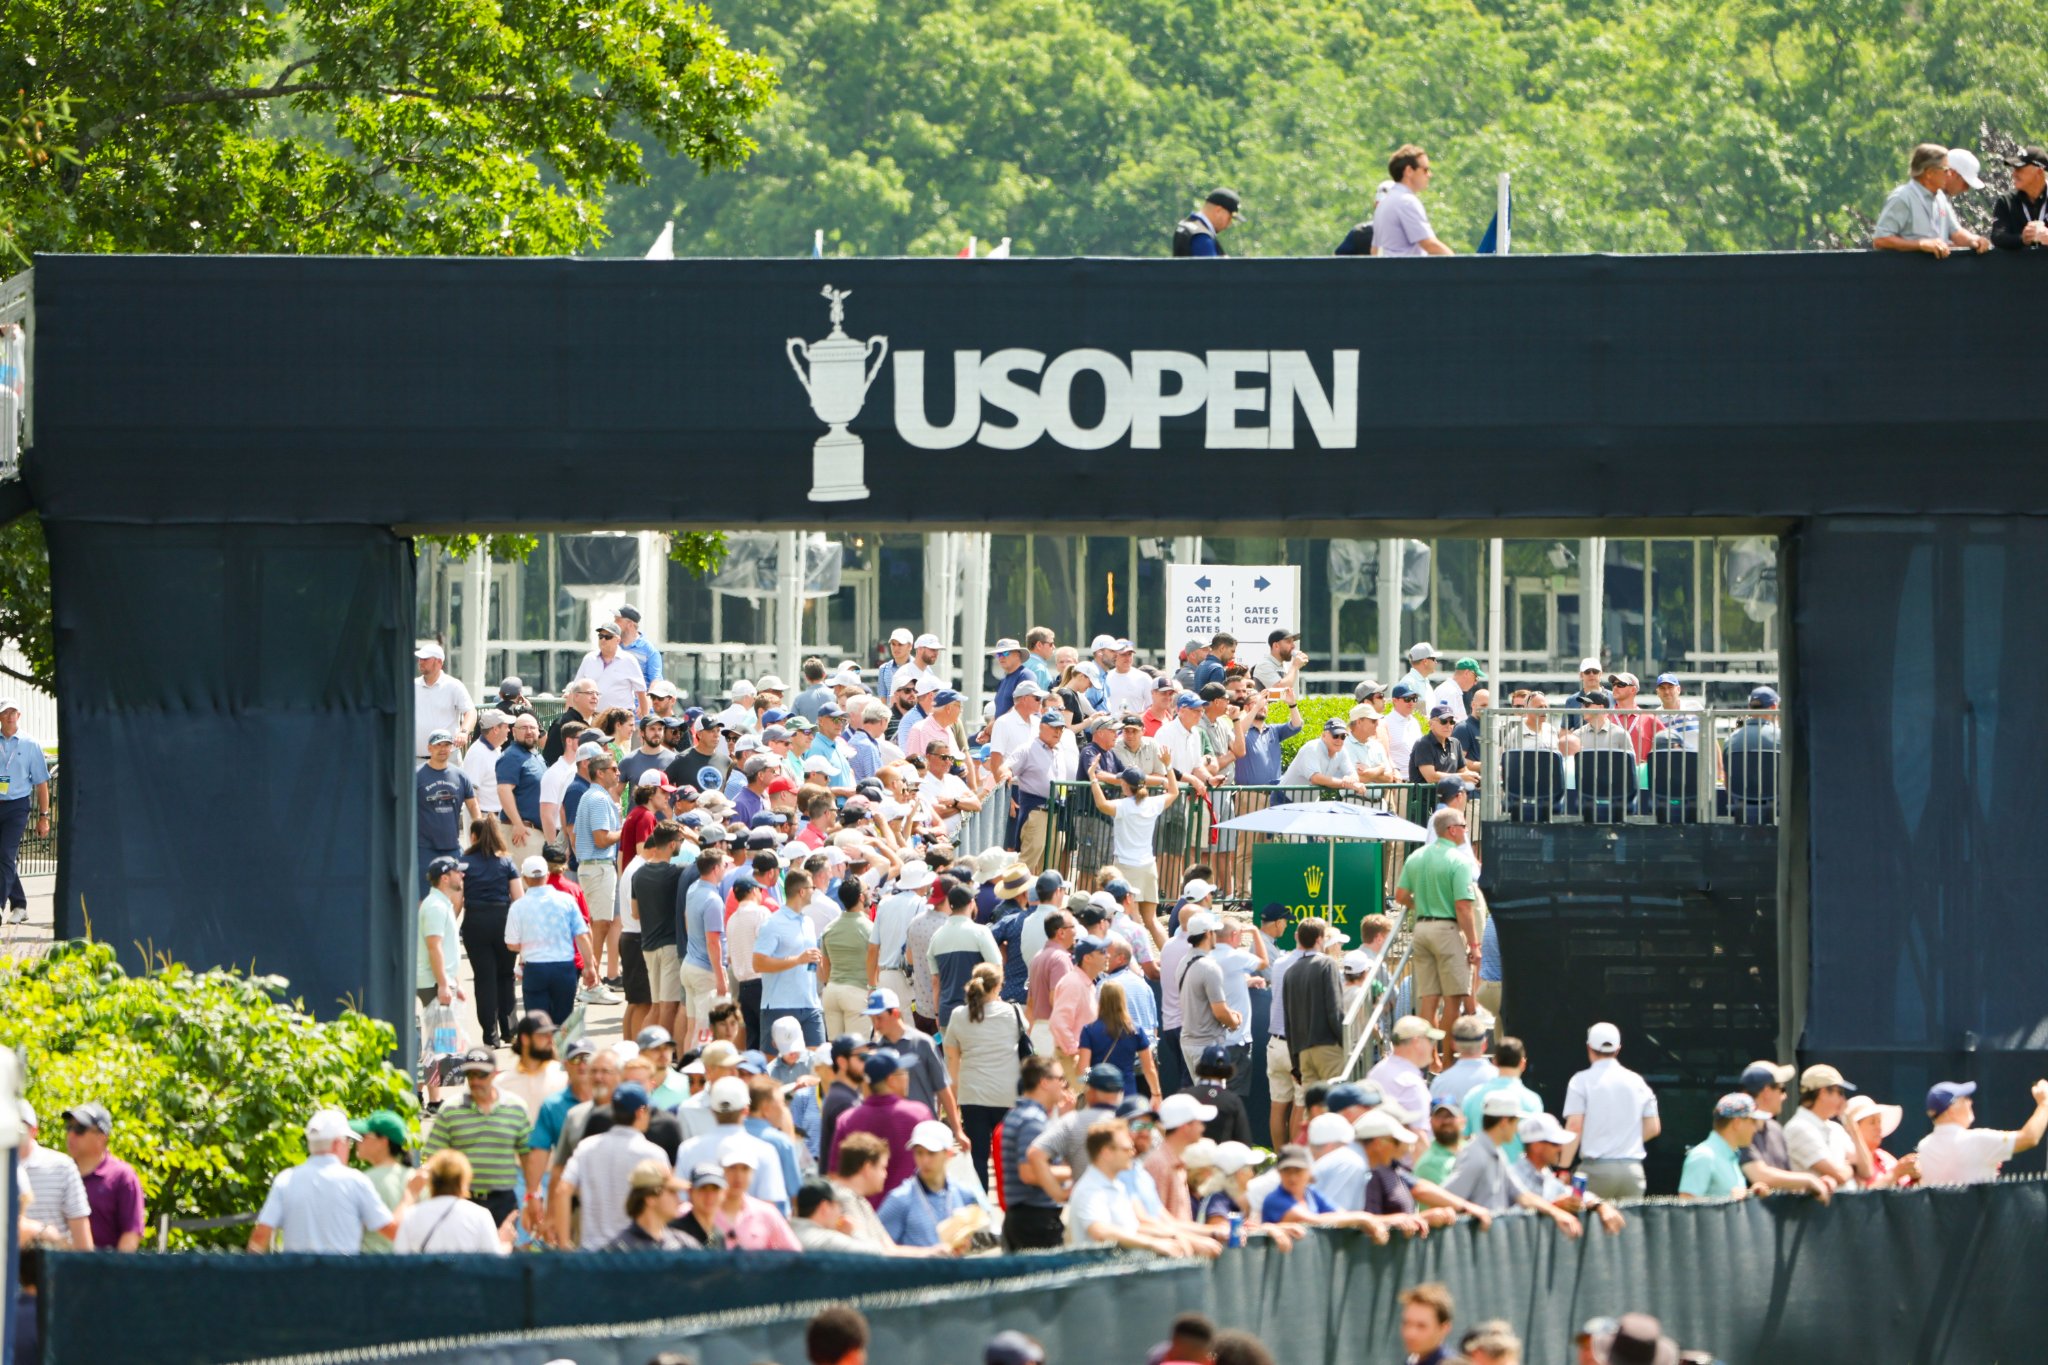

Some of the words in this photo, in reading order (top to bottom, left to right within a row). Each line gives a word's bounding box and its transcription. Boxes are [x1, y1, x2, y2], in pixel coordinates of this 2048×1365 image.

[1186, 595, 1213, 604] GATE
[1214, 595, 1221, 604] 2
[1186, 605, 1213, 614] GATE
[1214, 606, 1221, 614] 3
[1244, 606, 1270, 615] GATE
[1272, 606, 1279, 615] 6
[1186, 615, 1212, 624] GATE
[1214, 616, 1221, 624] 4
[1244, 616, 1270, 625] GATE
[1272, 617, 1279, 625] 7
[1186, 625, 1213, 634] GATE
[1214, 626, 1221, 634] 5
